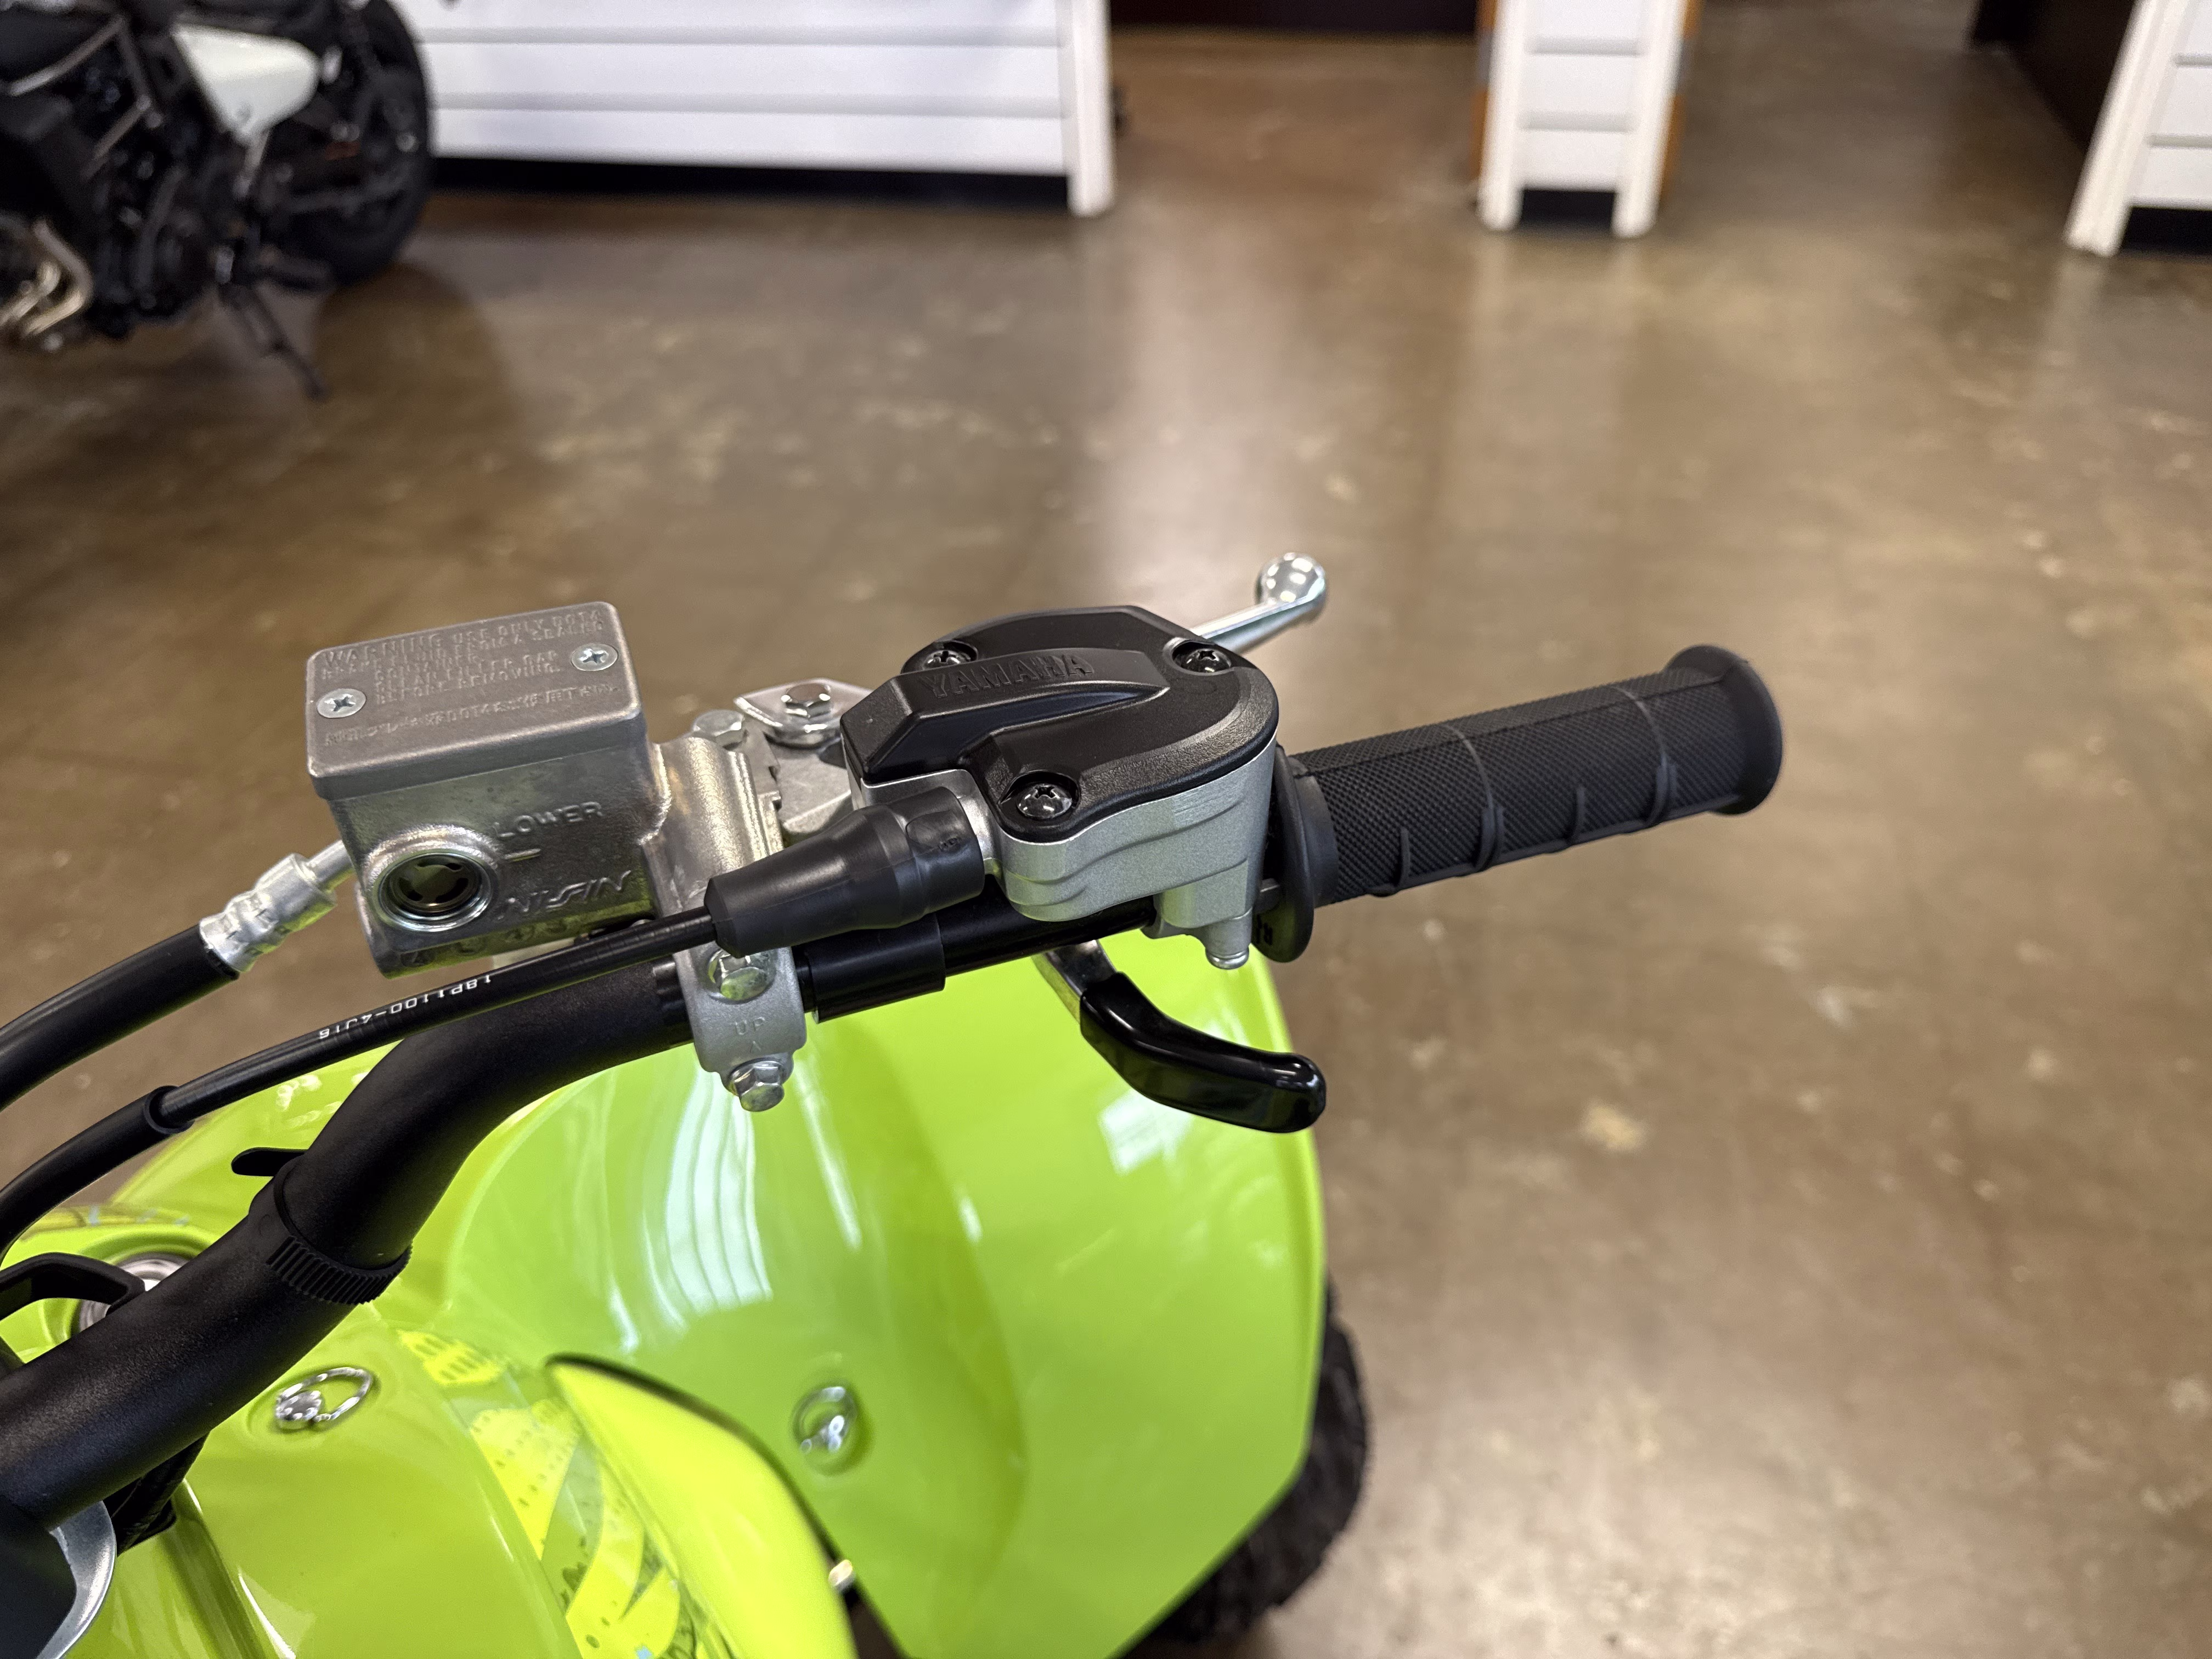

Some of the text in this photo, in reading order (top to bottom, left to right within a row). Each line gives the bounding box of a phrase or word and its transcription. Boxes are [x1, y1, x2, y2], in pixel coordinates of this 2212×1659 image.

[322, 633, 441, 664] WARNING
[452, 628, 488, 644] USE
[922, 654, 1095, 699] YAMAHA
[494, 801, 603, 838] LOWER
[734, 1017, 765, 1035] UP
